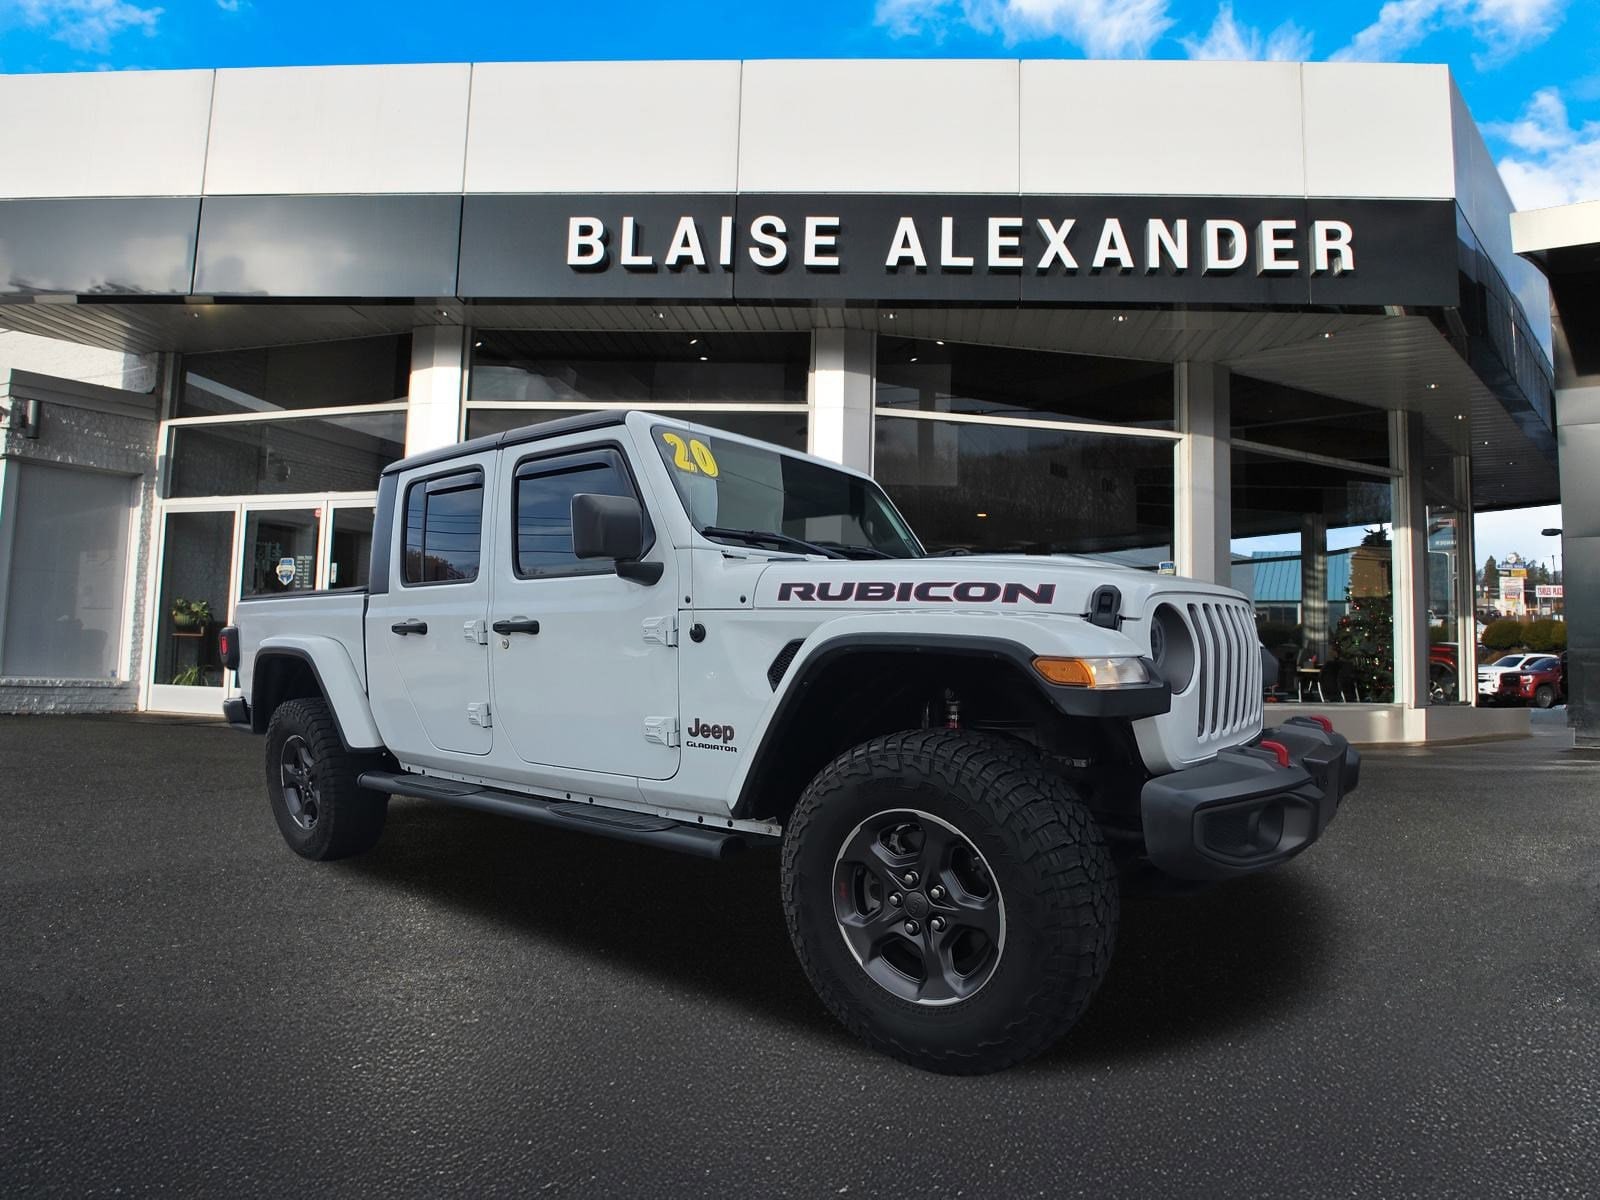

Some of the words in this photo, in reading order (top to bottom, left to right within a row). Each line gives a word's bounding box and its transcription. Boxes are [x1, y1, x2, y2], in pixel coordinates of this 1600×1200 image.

[567, 215, 841, 269] BLAISE
[885, 216, 1356, 274] ALEXANDER
[662, 432, 719, 478] 20
[777, 581, 1057, 605] RUBICON
[687, 717, 735, 744] Jeep
[686, 740, 738, 753] GLADIATOR
